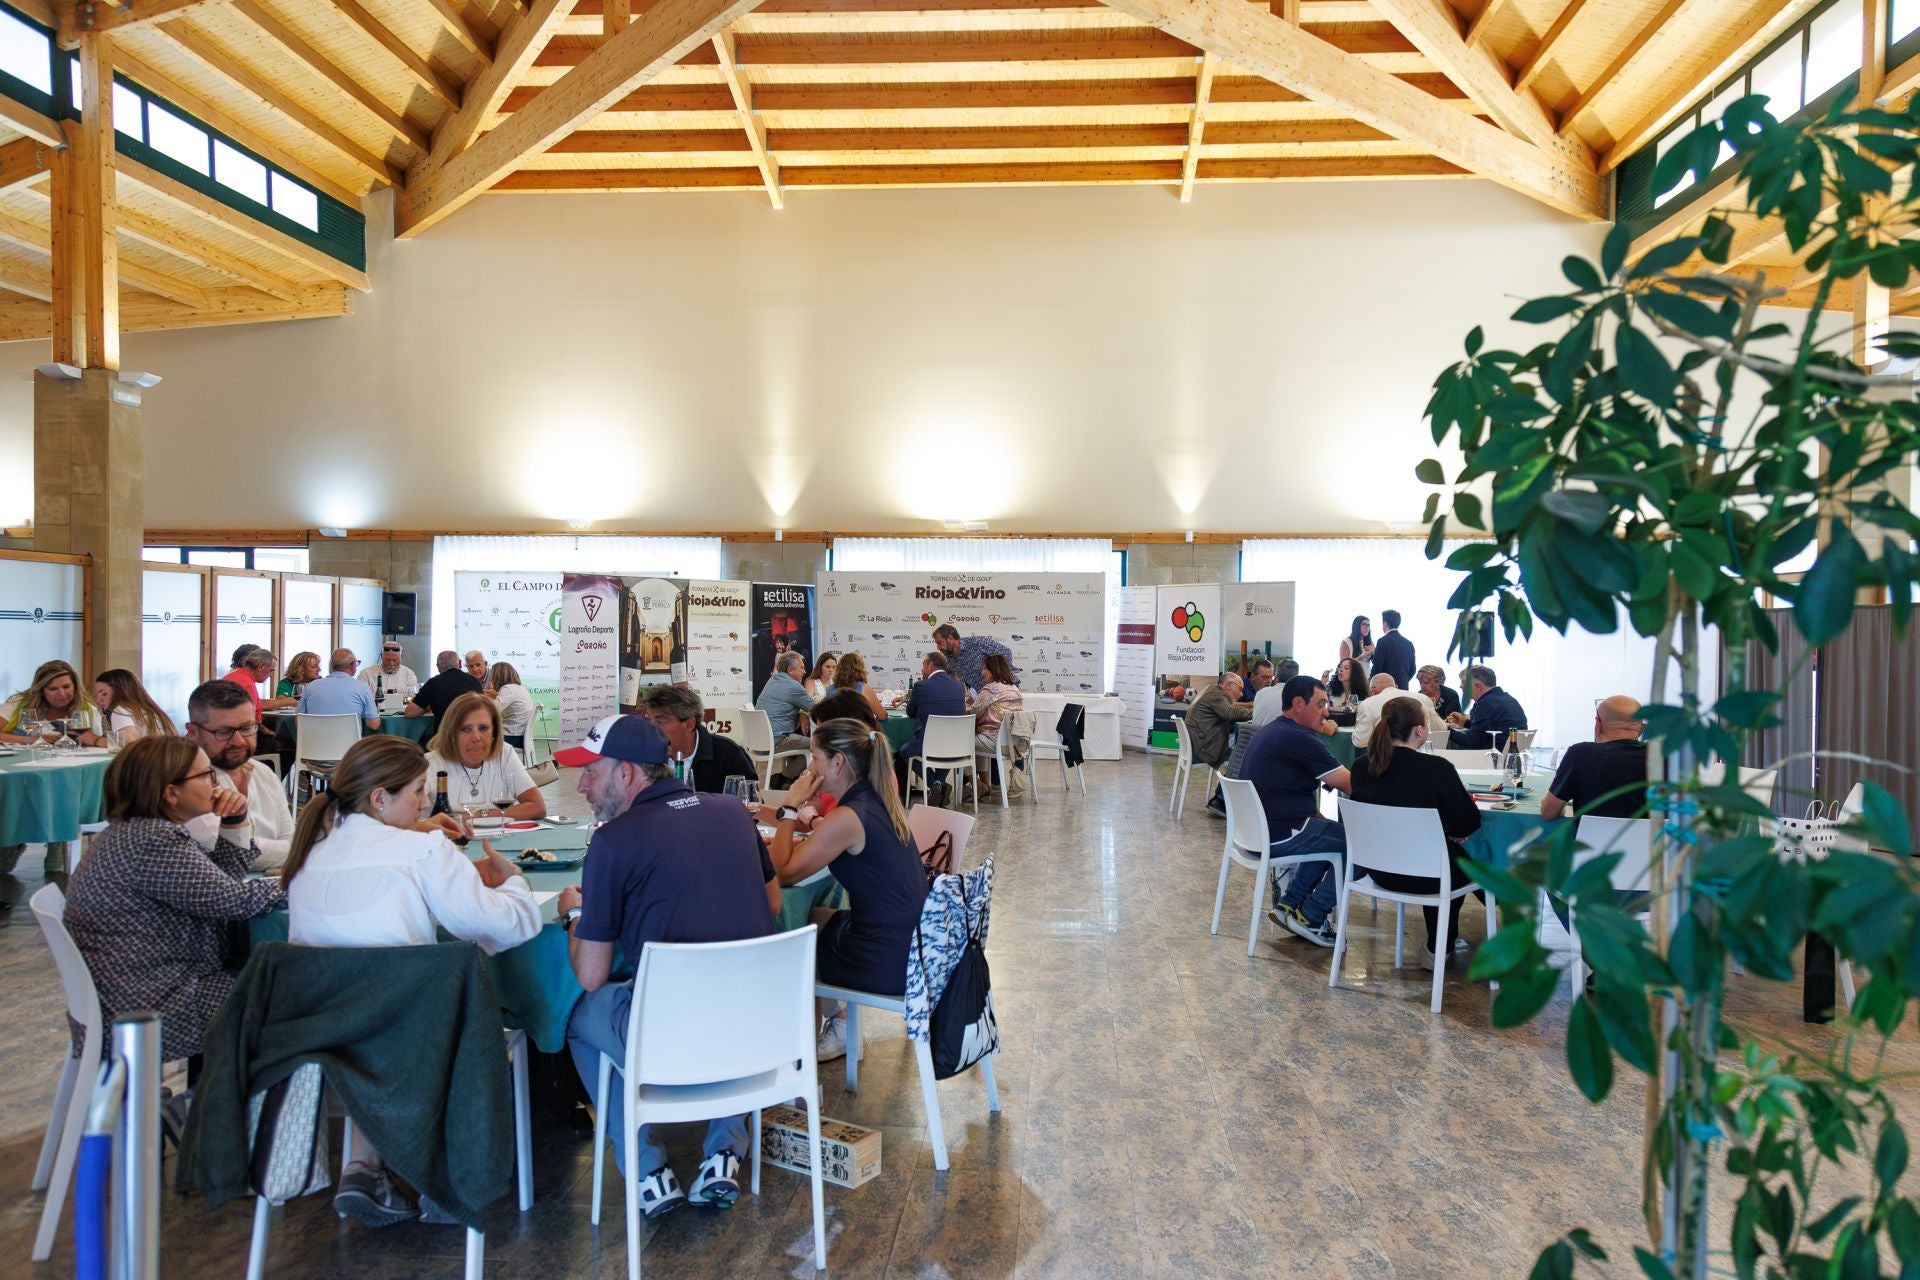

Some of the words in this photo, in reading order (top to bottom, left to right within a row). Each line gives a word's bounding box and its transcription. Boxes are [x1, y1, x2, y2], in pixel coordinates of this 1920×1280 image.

[498, 582, 510, 591] EL
[768, 588, 805, 603] etilisa
[915, 585, 1006, 601] Rioja&Vino
[875, 615, 892, 623] Rioja
[948, 614, 980, 623] LOGROÑO
[568, 625, 591, 635] Logroño
[592, 625, 614, 635] Deporte
[576, 639, 608, 650] LOGROÑO
[1176, 644, 1205, 654] Fundación
[1167, 653, 1181, 662] Rioja
[1182, 653, 1205, 662] Deporte
